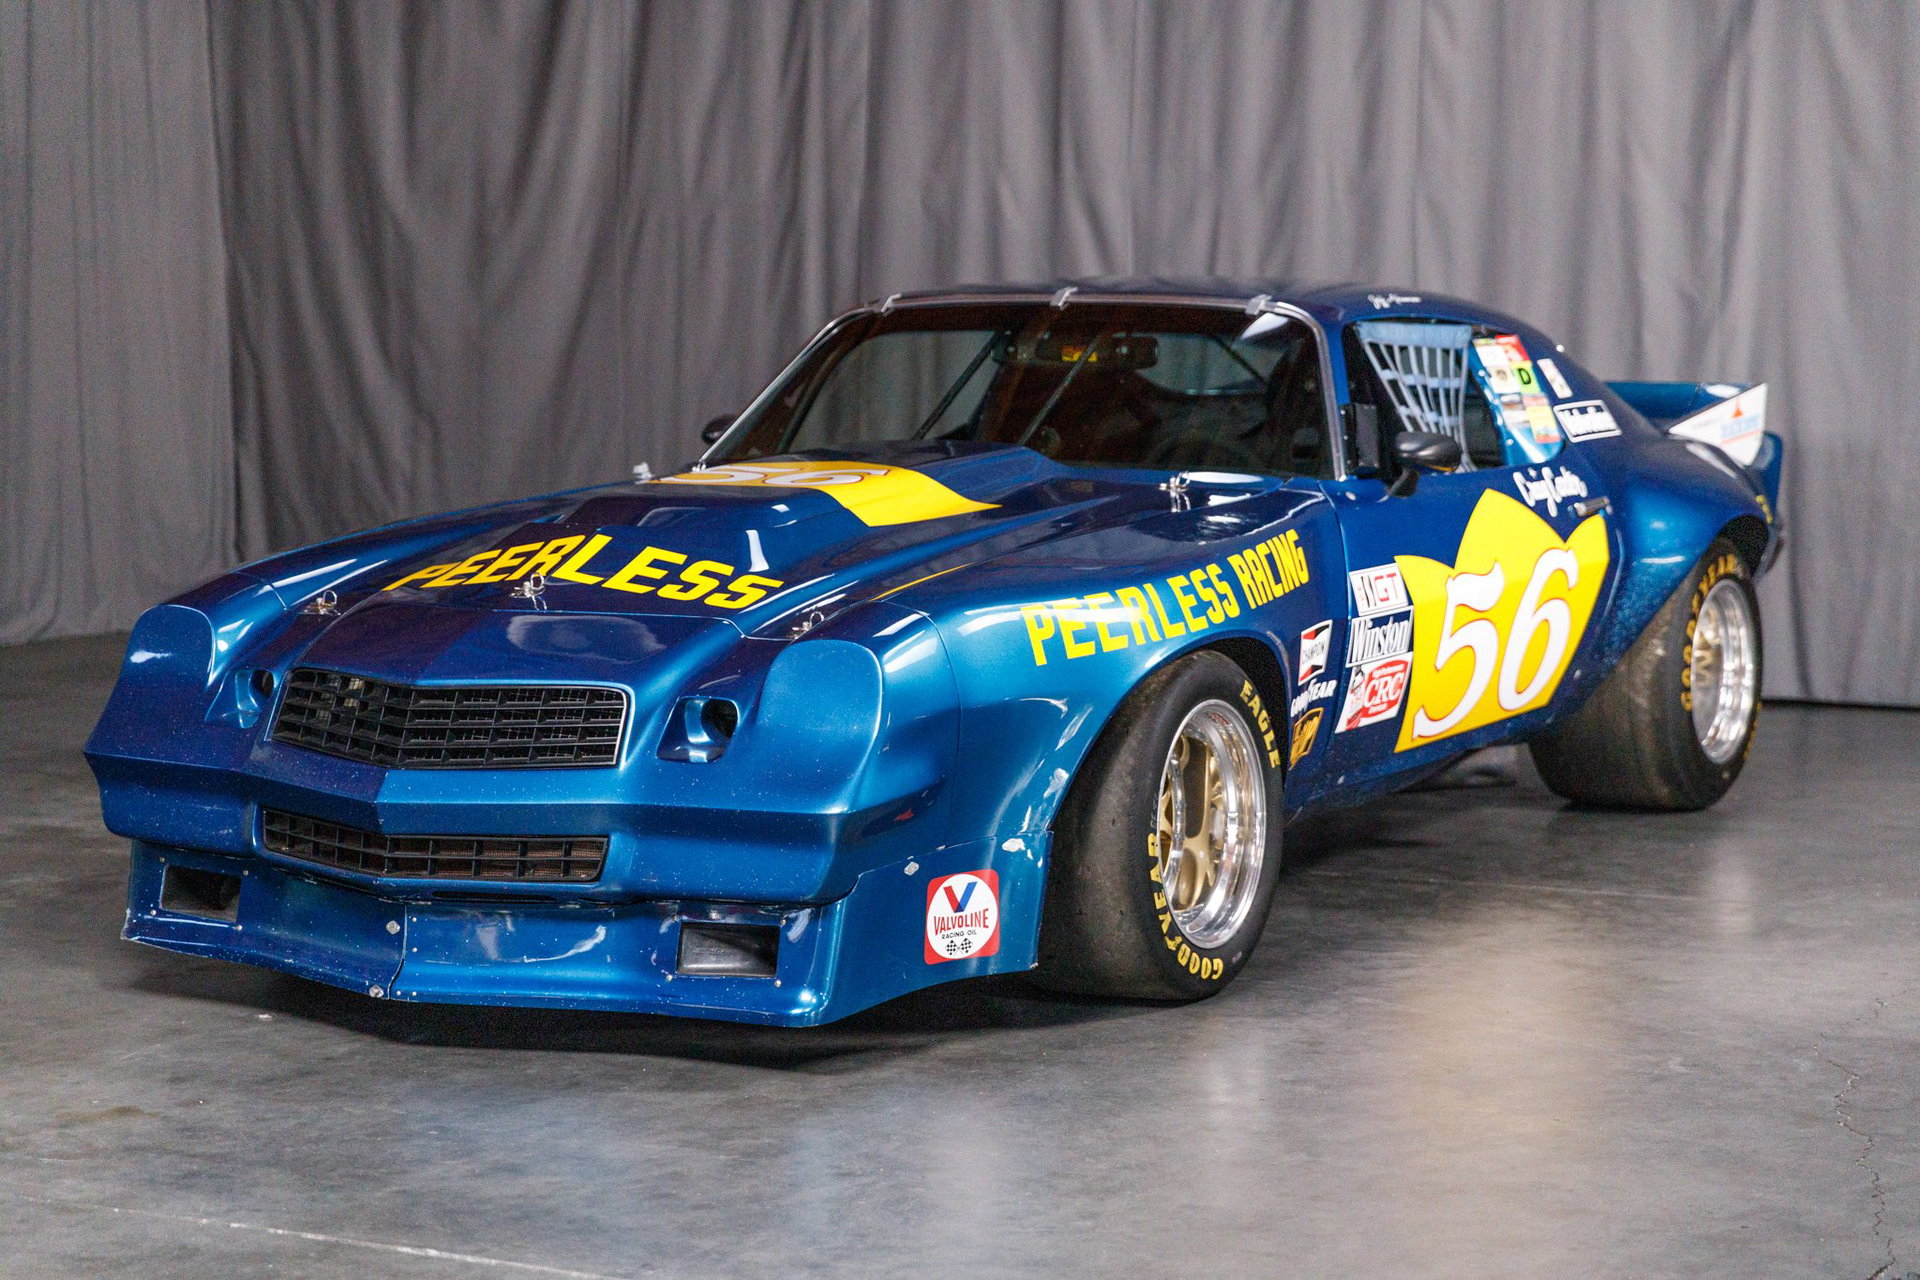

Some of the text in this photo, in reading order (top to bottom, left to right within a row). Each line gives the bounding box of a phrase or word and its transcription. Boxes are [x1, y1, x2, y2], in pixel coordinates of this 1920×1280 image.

[1517, 367, 1532, 385] D
[382, 533, 784, 609] PEERLESS
[1020, 528, 1310, 667] PEERLESS RACING
[1351, 615, 1409, 664] Winston
[1412, 547, 1579, 742] 56
[1291, 677, 1338, 718] GOODYEAR
[1364, 673, 1406, 709] CRC
[1239, 679, 1281, 769] EAGLE
[933, 908, 989, 935] VALVOLINE
[1147, 832, 1225, 981] GOODYEAR
[941, 931, 965, 940] RACING
